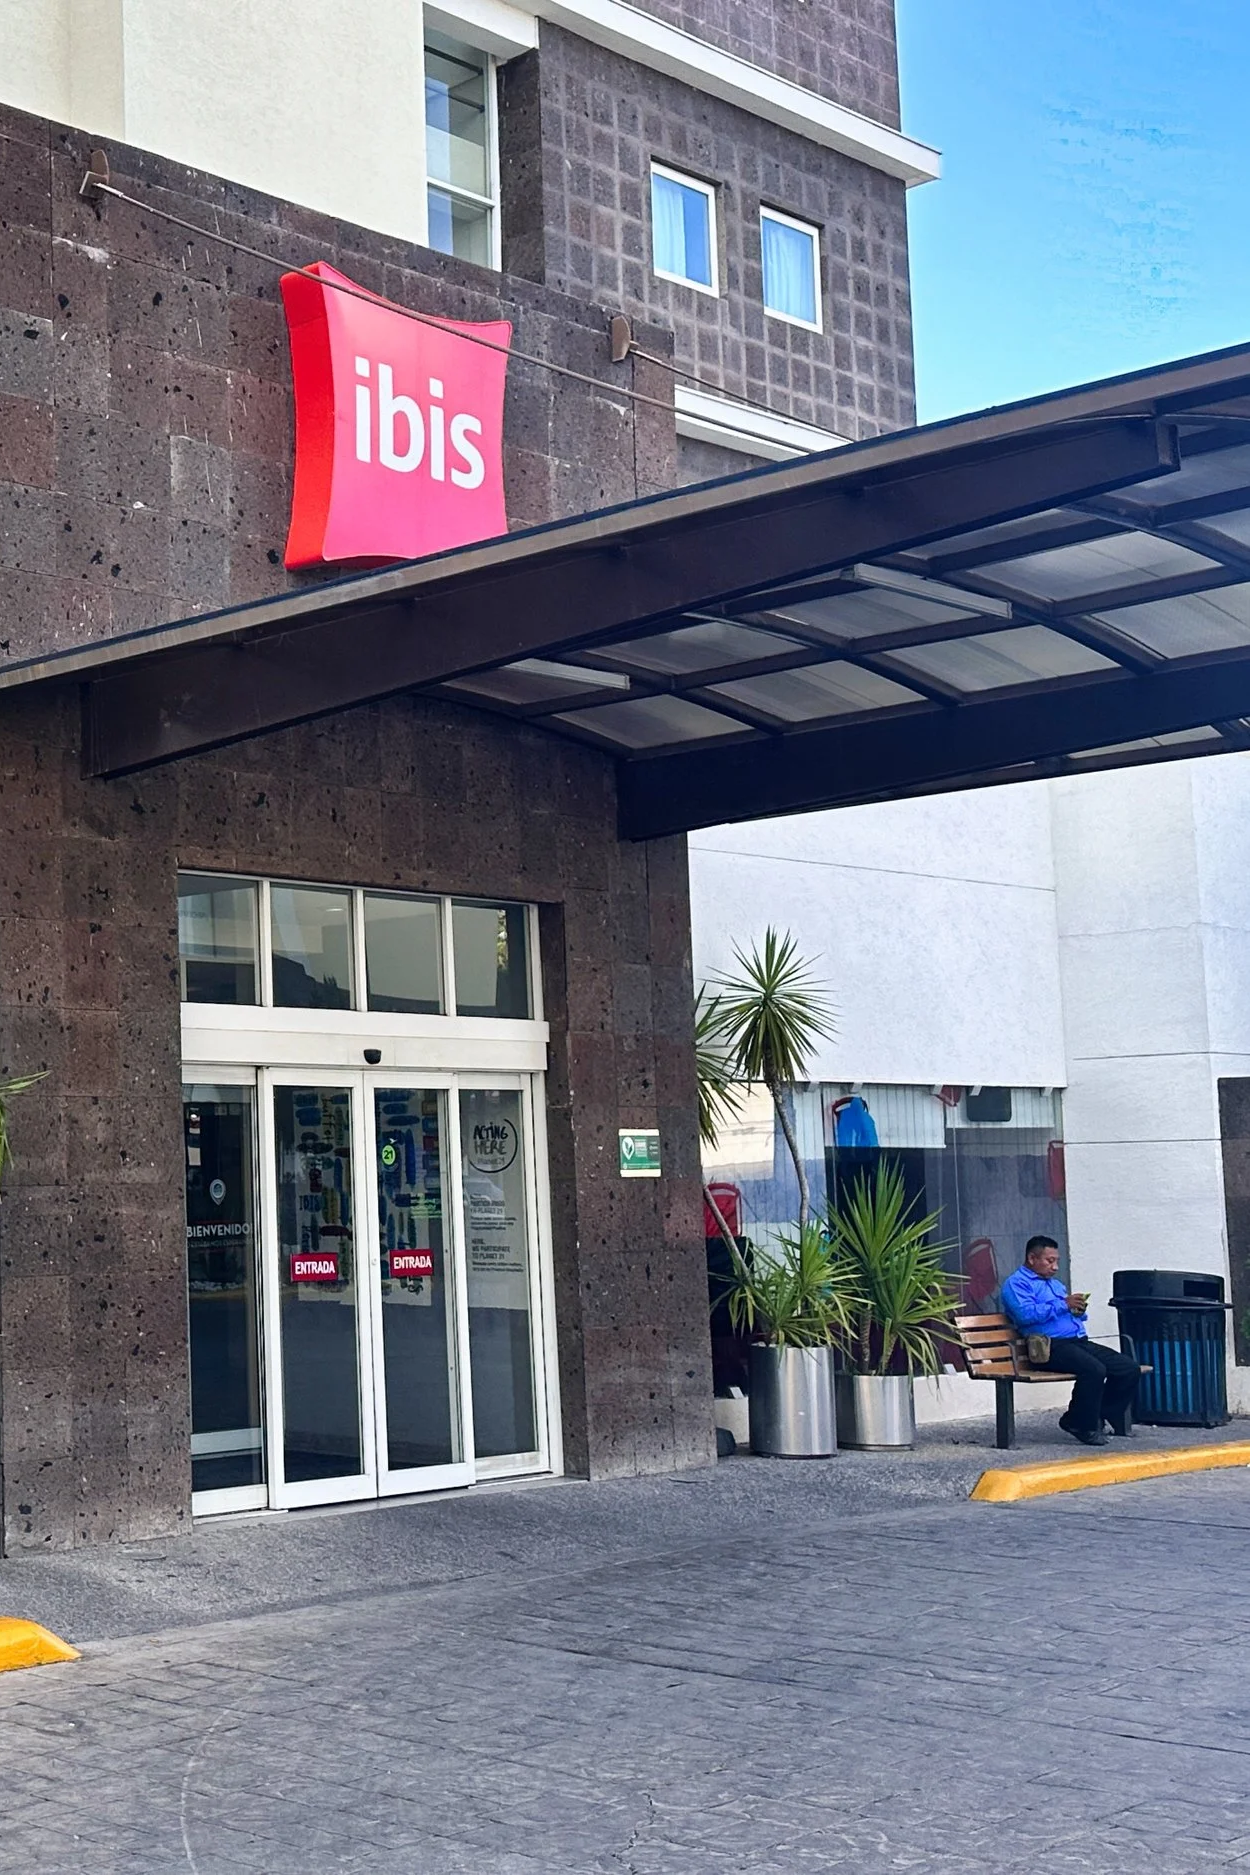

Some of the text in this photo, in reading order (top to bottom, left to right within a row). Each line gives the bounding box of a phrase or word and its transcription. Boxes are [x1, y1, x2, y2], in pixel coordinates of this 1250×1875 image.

[355, 355, 485, 490] ibis
[473, 1122, 508, 1140] ACTING
[474, 1140, 507, 1155] HERE
[186, 1222, 250, 1238] BIENVENIDO
[295, 1260, 335, 1275] ENTRADA
[393, 1255, 432, 1270] ENTRADA
